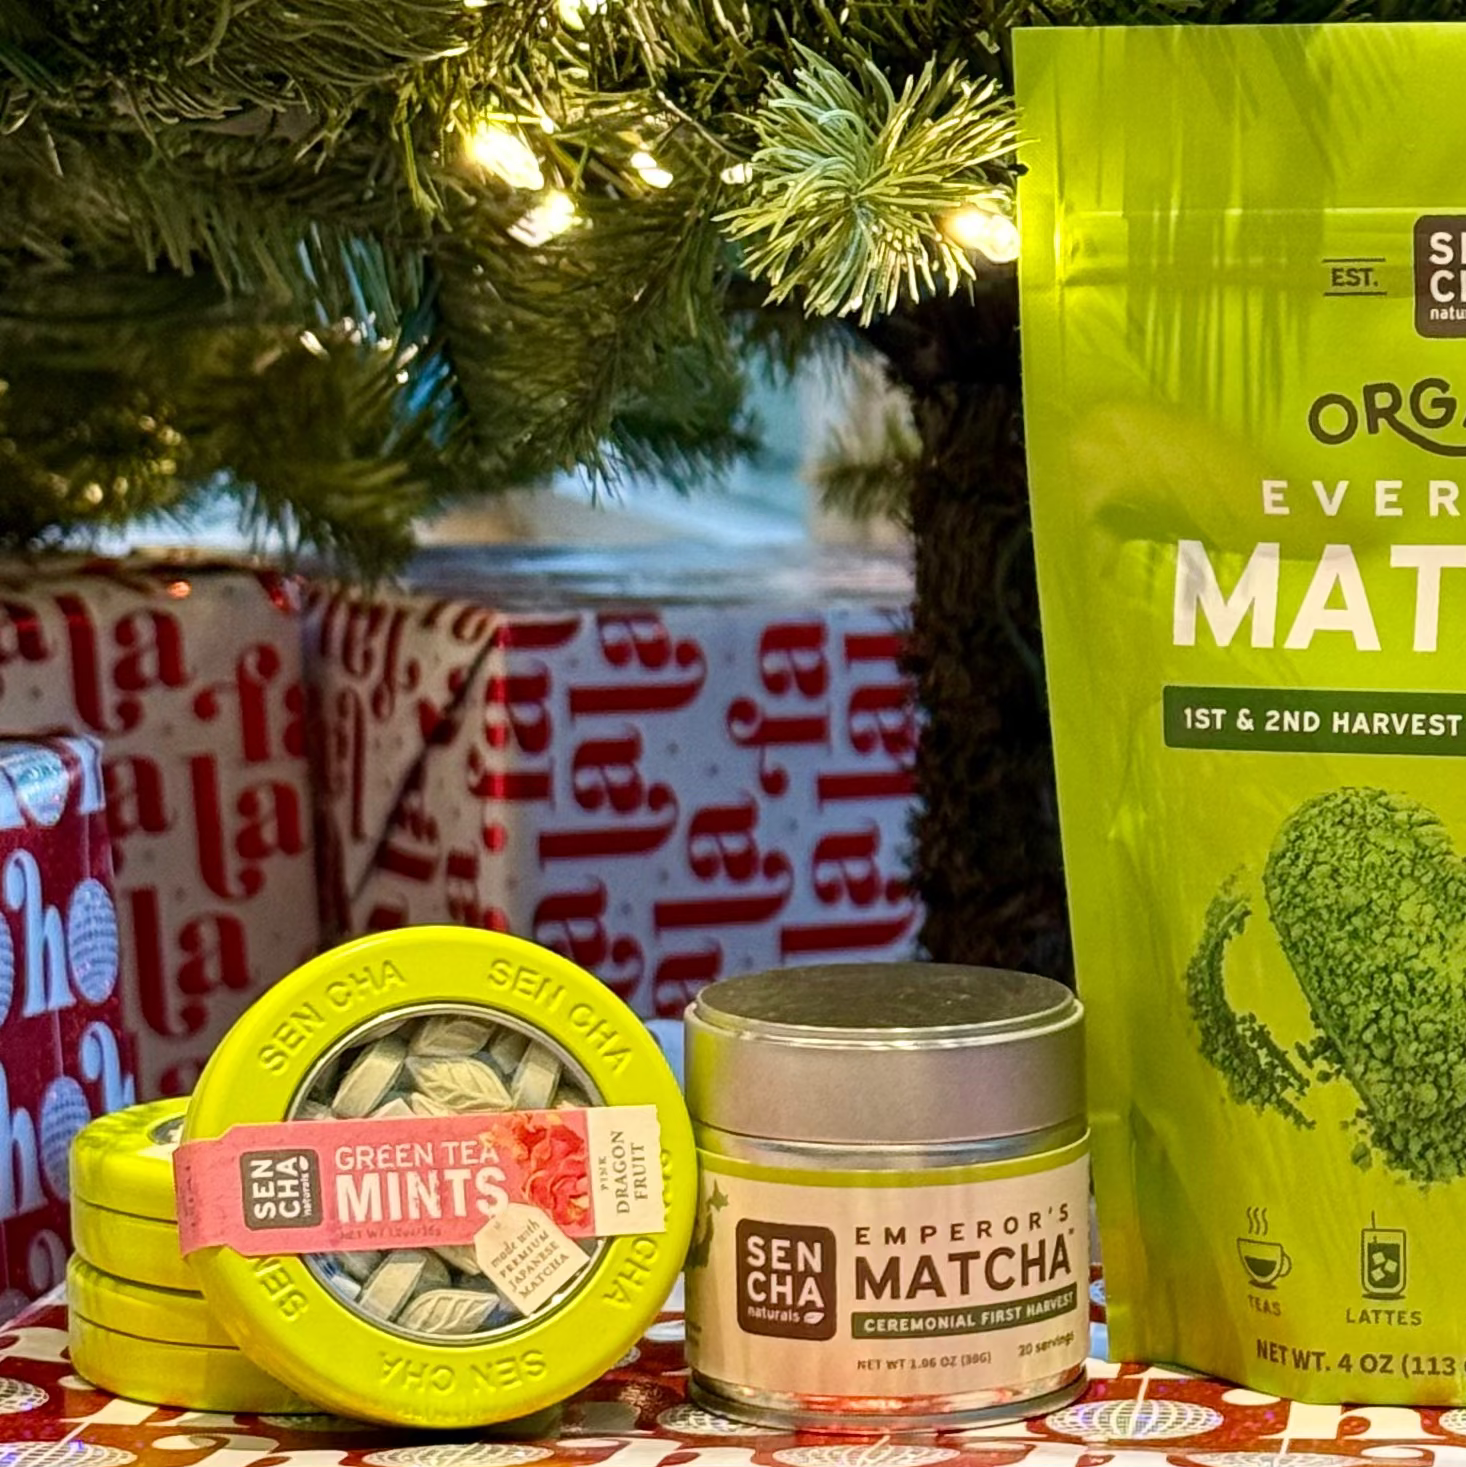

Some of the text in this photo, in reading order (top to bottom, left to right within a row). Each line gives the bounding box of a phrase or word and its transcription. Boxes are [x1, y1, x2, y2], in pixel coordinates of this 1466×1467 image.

[1331, 267, 1379, 288] EST.
[1184, 707, 1227, 730] 1ST
[1235, 707, 1255, 731] &
[1264, 710, 1321, 733] 2ND
[1331, 711, 1463, 737] HARVEST
[257, 958, 409, 1077] SEN CHA
[486, 957, 637, 1077] SEN CHA
[335, 1139, 500, 1171] GREEN TEA
[610, 1130, 632, 1215] DRAGON
[629, 1142, 649, 1201] FRUIT
[249, 1158, 277, 1220] SEN
[275, 1155, 301, 1219] CHA
[335, 1165, 510, 1225] MINTS
[854, 1202, 1069, 1246] EMPEROR'S
[490, 1239, 518, 1269] made
[498, 1230, 550, 1279] PREMIUM
[508, 1240, 562, 1292] JAPANESE
[518, 1252, 570, 1300] MATCHA
[745, 1235, 823, 1273] SEN
[854, 1232, 1073, 1301] MATCHA
[746, 1270, 825, 1309] CHA
[1247, 1294, 1282, 1317] TEAS
[747, 1304, 801, 1324] naturals
[863, 1290, 1074, 1334] CEREMONIAL FIRST HARVEST
[1345, 1307, 1423, 1327] LATTES
[856, 1358, 881, 1371] NET
[886, 1358, 906, 1371] WT
[940, 1354, 958, 1368] OZ
[1017, 1330, 1075, 1357] 20 servings
[1256, 1338, 1291, 1366] NET
[1292, 1347, 1332, 1373] WT.
[1337, 1353, 1353, 1374] 4
[1359, 1353, 1395, 1375] OZ
[1400, 1353, 1457, 1379] (113
